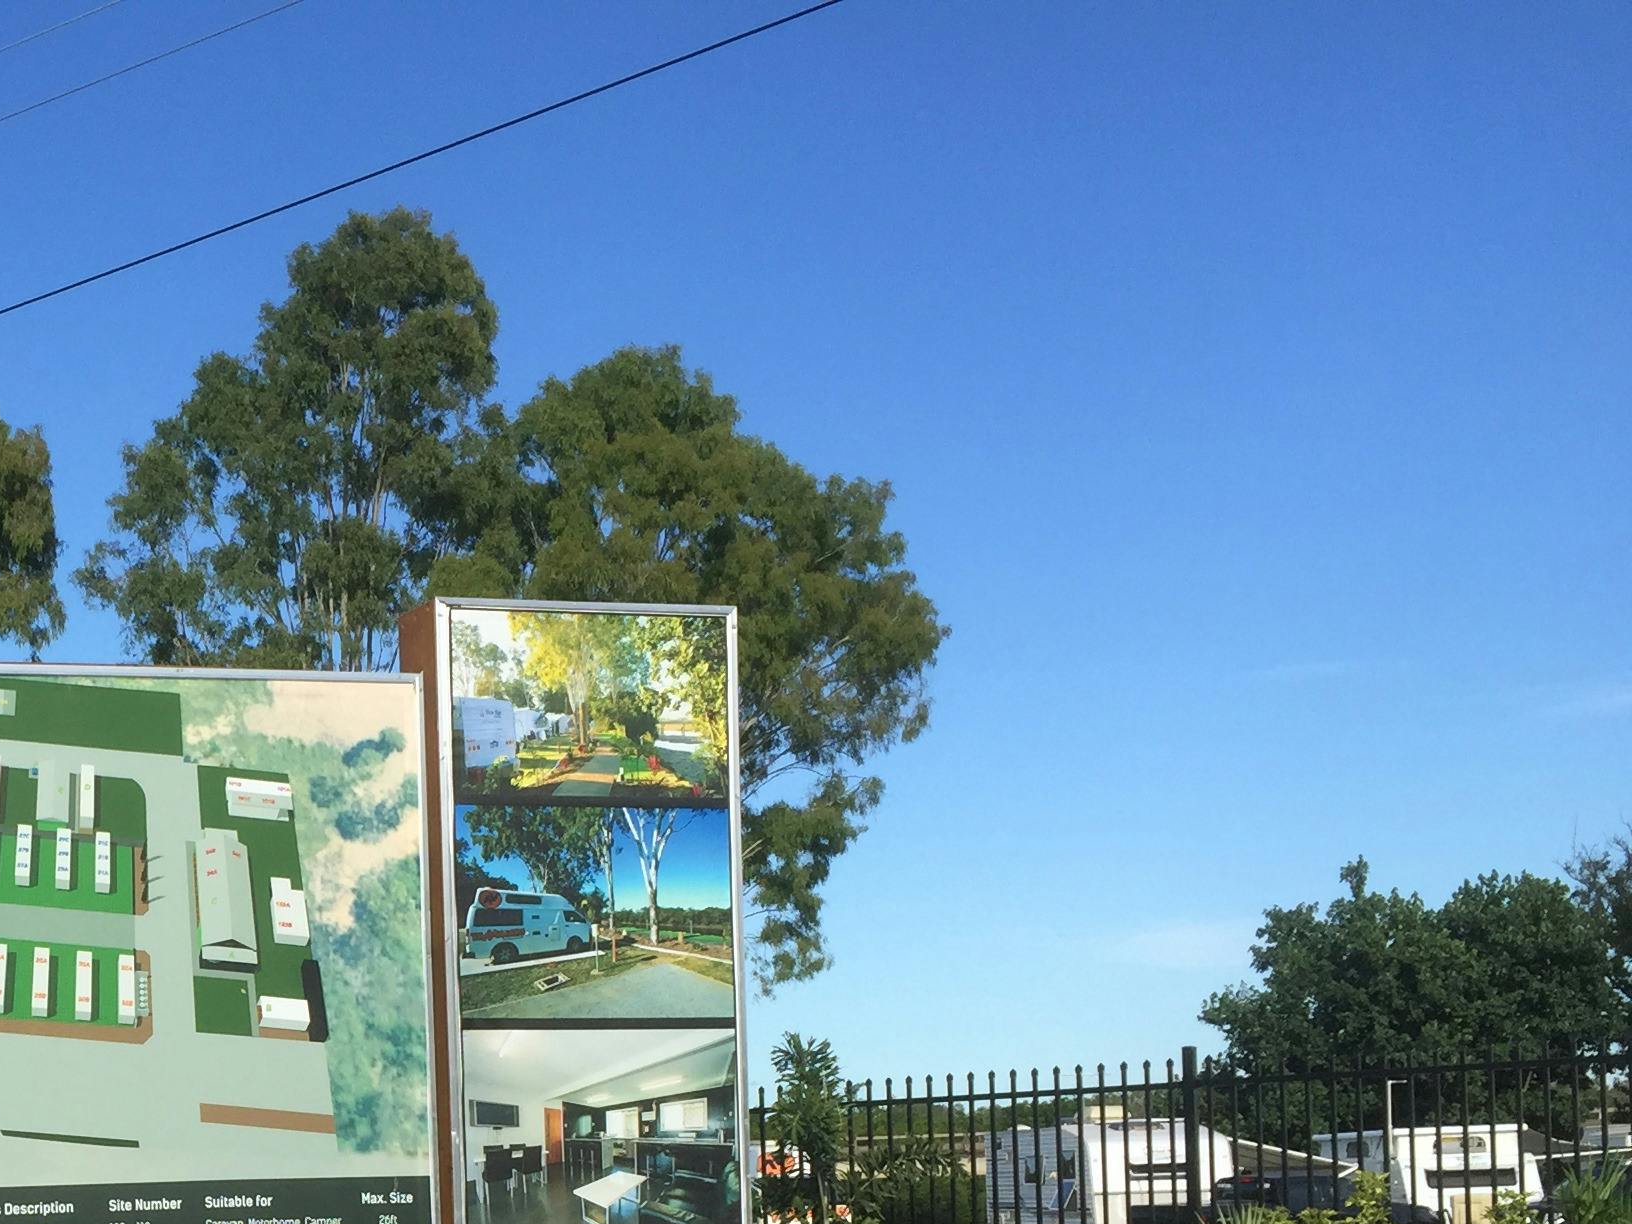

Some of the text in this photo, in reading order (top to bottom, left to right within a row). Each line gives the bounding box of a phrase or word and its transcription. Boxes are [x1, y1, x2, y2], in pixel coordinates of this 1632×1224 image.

[205, 1195, 273, 1208] Suitable for
[389, 1192, 413, 1203] Size
[5, 1201, 73, 1216] Description
[109, 1198, 182, 1211] Site Number
[379, 1215, 397, 1224] 26ft
